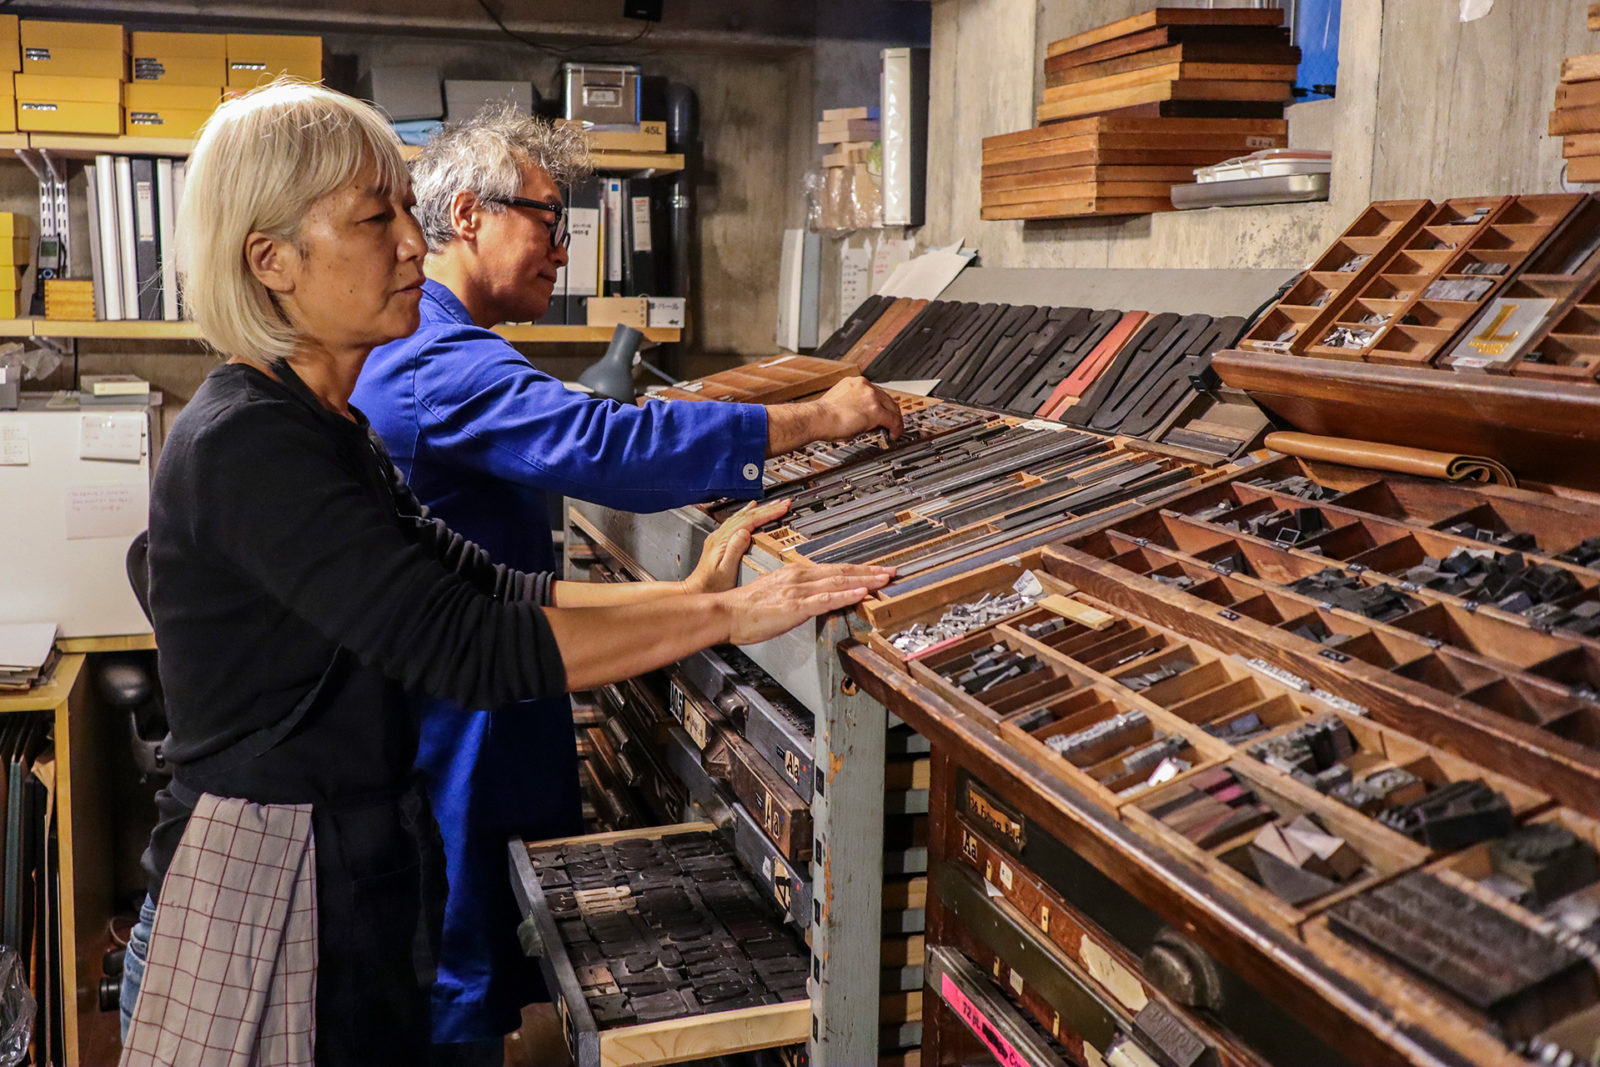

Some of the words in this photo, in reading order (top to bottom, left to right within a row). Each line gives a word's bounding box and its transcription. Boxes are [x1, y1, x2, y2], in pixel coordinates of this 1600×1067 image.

[644, 127, 663, 136] 45L
[1473, 304, 1520, 342] L
[786, 752, 800, 785] Aa
[764, 790, 780, 840] Aa
[963, 833, 977, 860] Aa
[962, 1002, 973, 1019] 72
